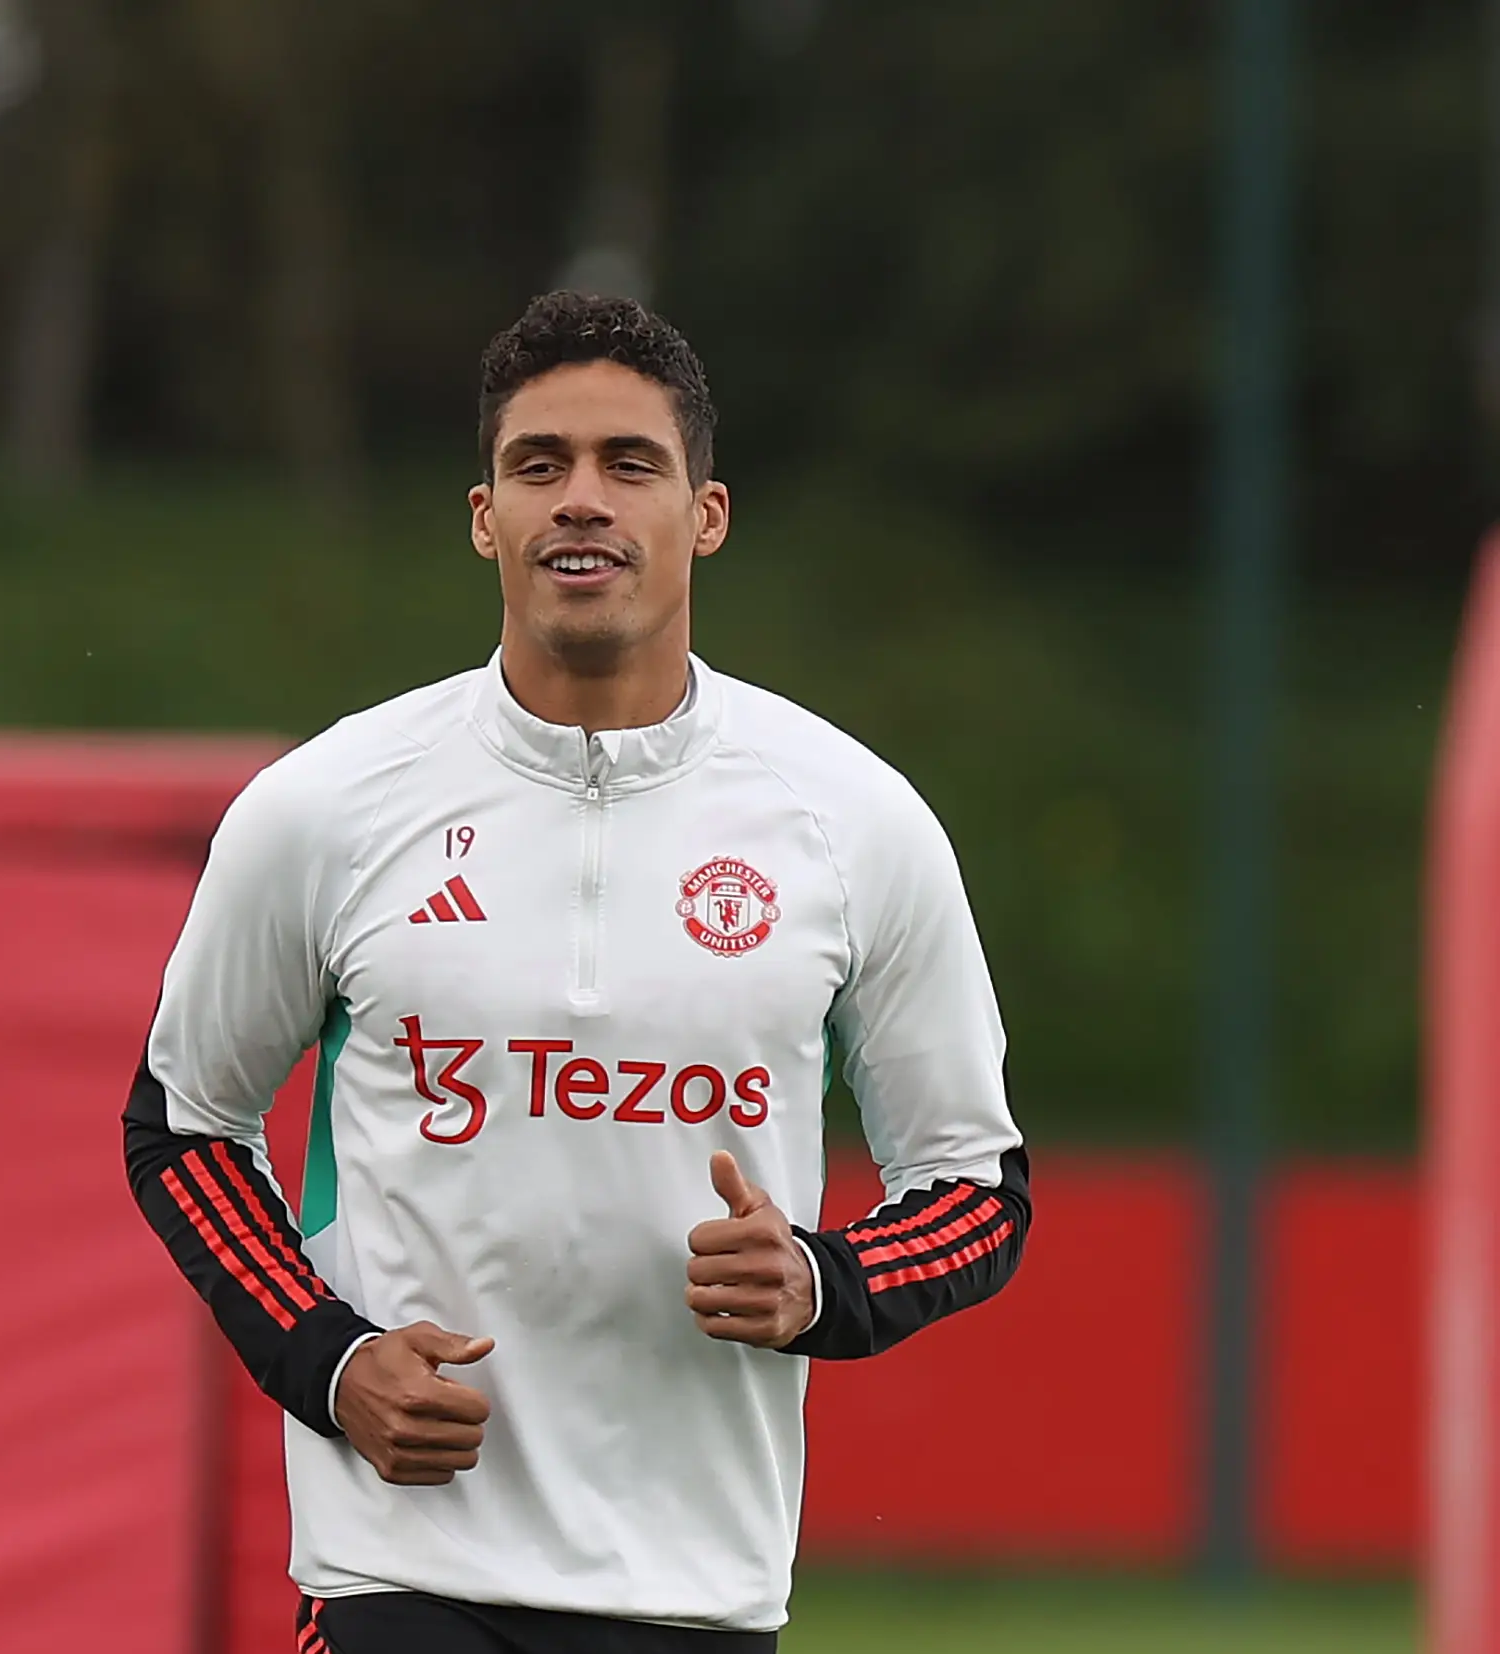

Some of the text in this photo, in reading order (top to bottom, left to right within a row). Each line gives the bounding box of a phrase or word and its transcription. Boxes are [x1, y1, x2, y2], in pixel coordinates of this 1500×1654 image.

[445, 826, 475, 859] 19
[687, 862, 771, 897] MANCHESTER
[699, 930, 758, 949] UNITED
[507, 1039, 771, 1128] Tezos
